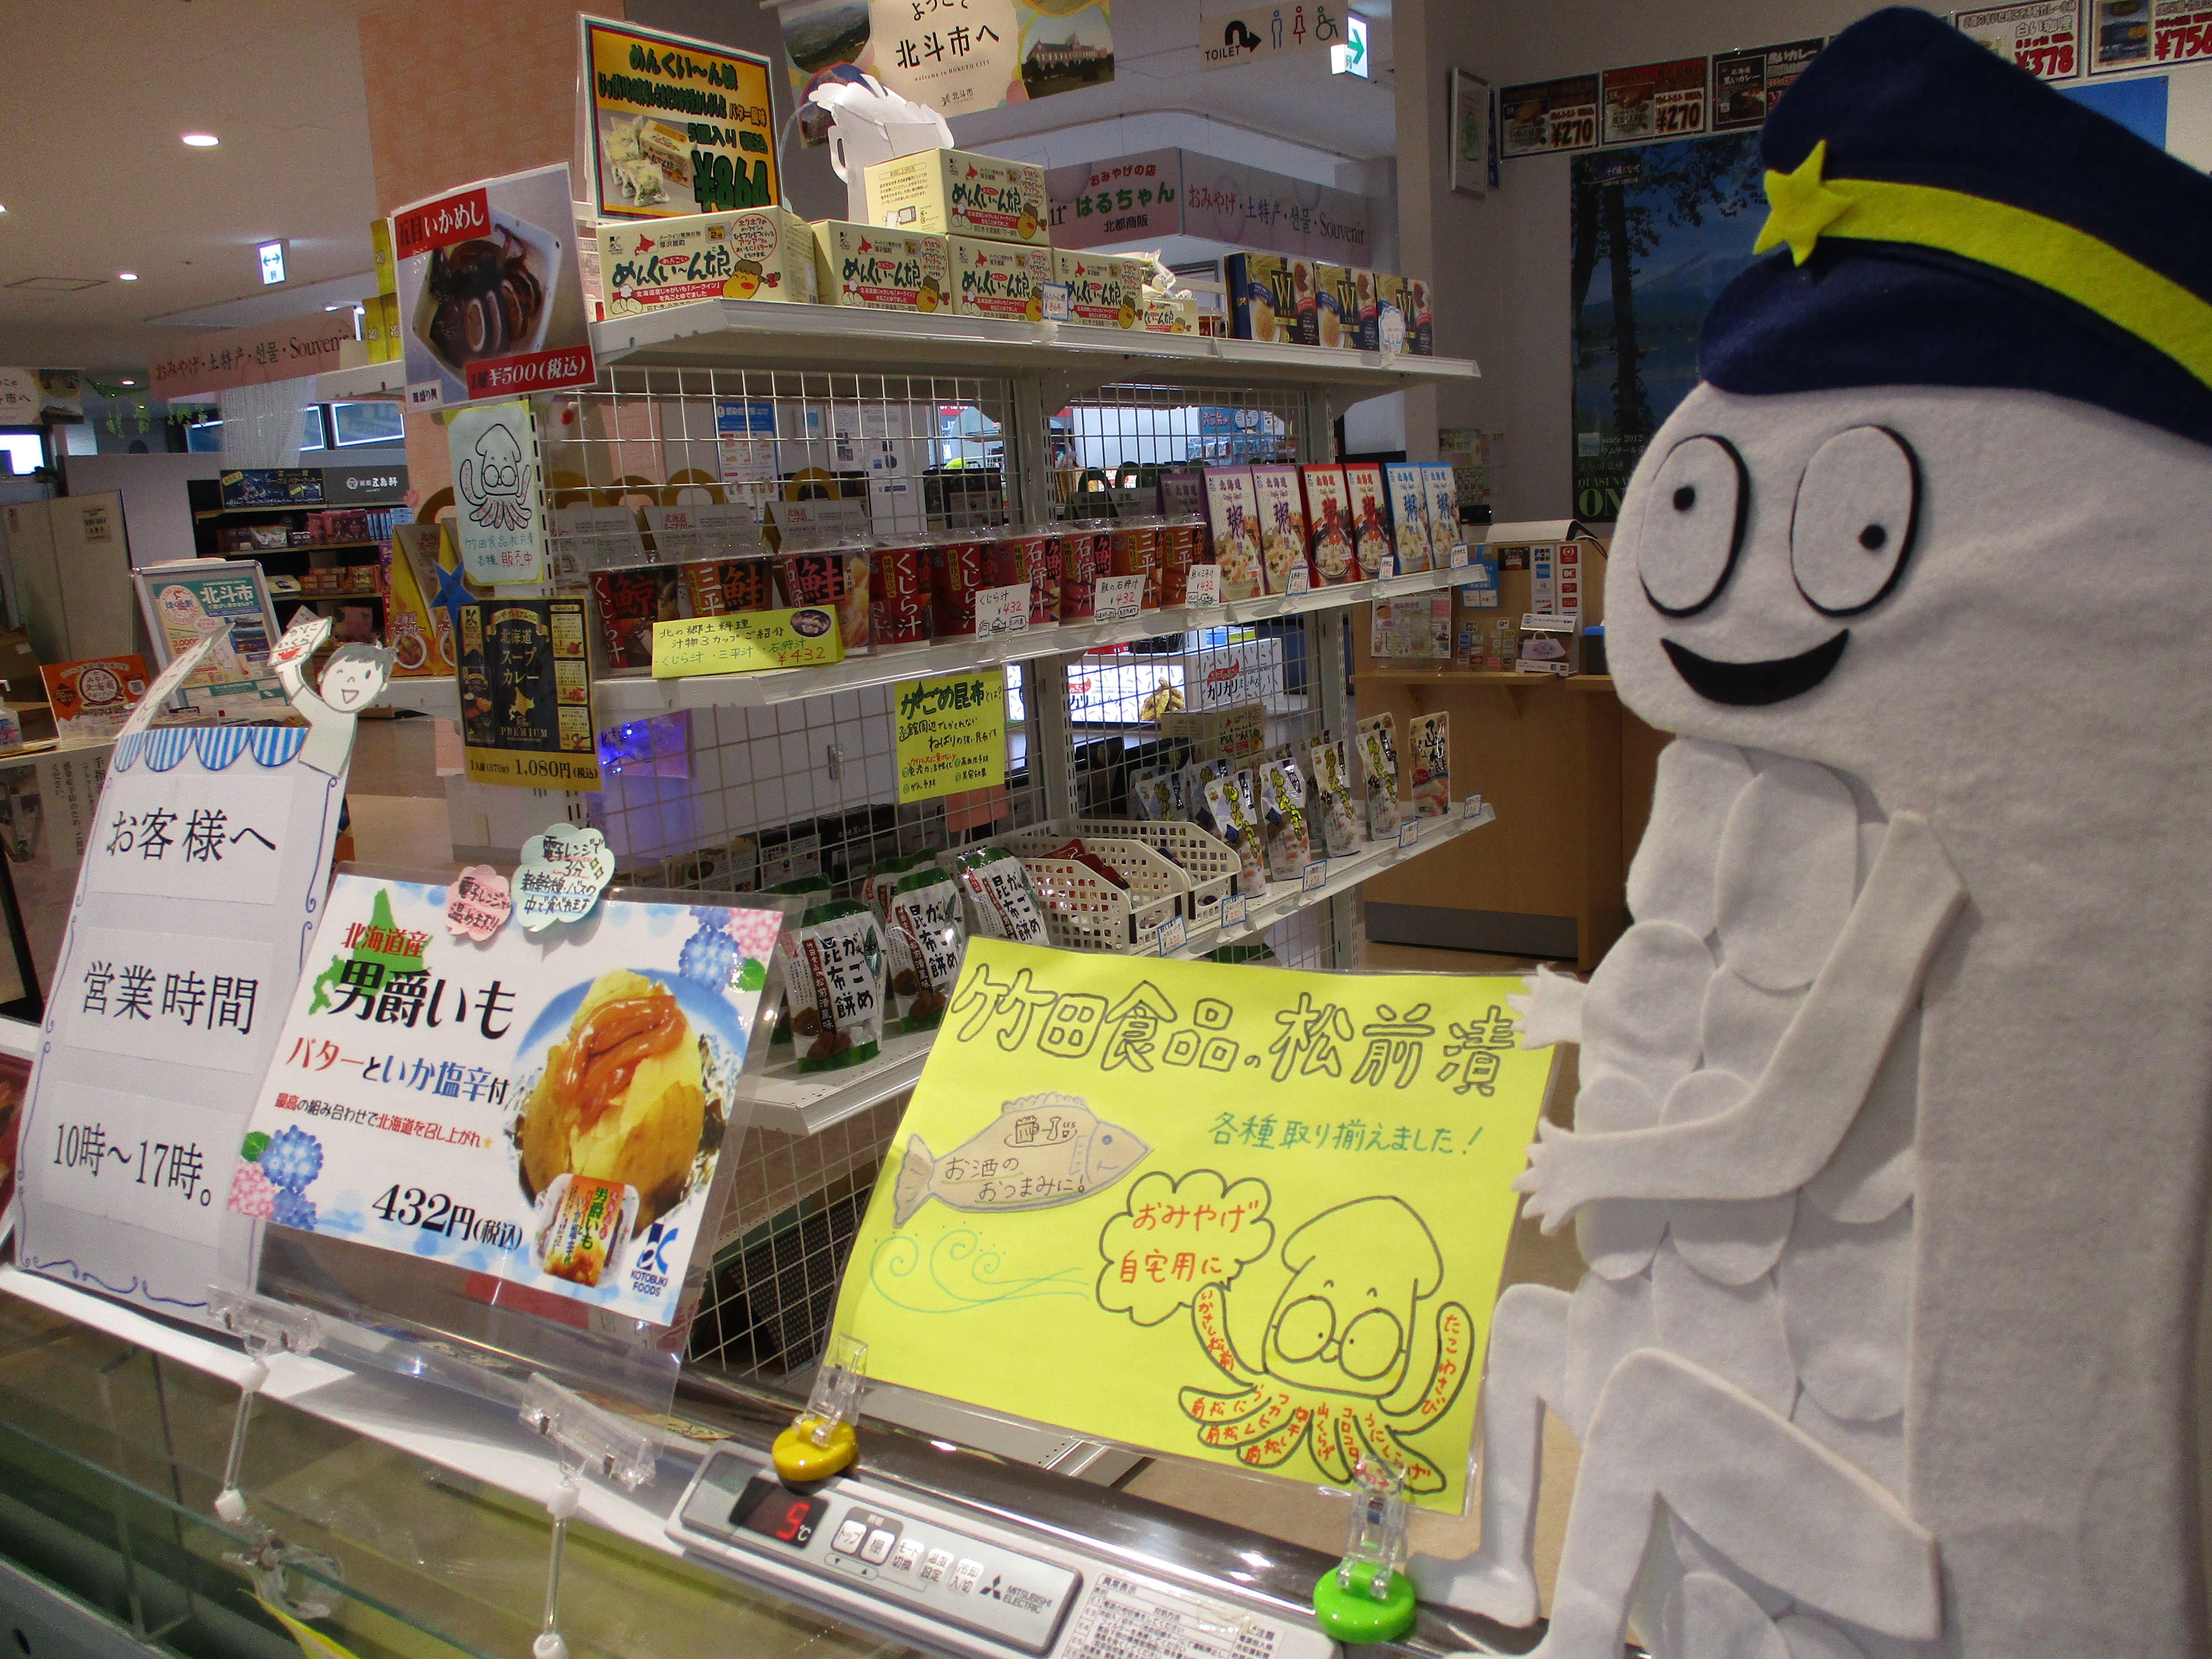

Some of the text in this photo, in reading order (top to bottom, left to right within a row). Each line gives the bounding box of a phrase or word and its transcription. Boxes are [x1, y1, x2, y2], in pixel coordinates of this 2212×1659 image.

[912, 0, 968, 21] よう
[895, 23, 1000, 70] 北斗市へ
[1205, 45, 1241, 61] TOILET
[914, 71, 939, 83] welcome
[948, 64, 974, 75] HOKUTO
[975, 59, 991, 69] CITY
[2014, 44, 2074, 76] ¥378
[951, 88, 974, 100] 北斗市
[729, 103, 767, 128] バター風味
[1655, 102, 1701, 135] ¥270
[1550, 119, 1594, 149] ¥270
[1088, 163, 1157, 188] おみやげの店
[1075, 180, 1176, 219] はるちゃん
[1103, 213, 1149, 234] 北都商販
[1188, 184, 1237, 214] おみやげ
[1319, 211, 1366, 246] Souvenir
[659, 240, 686, 250] 厚沢部町
[636, 283, 720, 298] 北海道産じゃがいも「メークイン」
[1271, 275, 1293, 312] W
[1337, 283, 1357, 319] W
[1044, 302, 1062, 313] ¥864
[290, 328, 349, 359] Souven
[489, 356, 586, 386] ¥500(税込)
[1623, 434, 1644, 443] 2012
[501, 550, 533, 568] 販売中
[1534, 548, 1551, 561] JCB
[799, 556, 844, 601] 鮭
[1025, 539, 1048, 619] 石狩汁
[1100, 579, 1139, 594] 鮭の石狩汁
[1190, 569, 1214, 580] 鮭の三平汁
[1196, 580, 1214, 591] ¥432
[200, 584, 253, 604] 北斗市
[896, 552, 921, 639] くじら汁
[979, 590, 1010, 604] くじら汁
[1110, 592, 1135, 606] ¥432
[593, 576, 625, 665] くじら汁
[997, 602, 1023, 616] ¥432
[500, 628, 532, 644] 北海道
[659, 619, 752, 639] 北の郷土料理
[501, 647, 537, 666] スープ
[777, 646, 827, 666] ¥432
[502, 668, 540, 685] カレー
[900, 680, 1003, 720] がごめ昆布とは?
[500, 726, 548, 738] PREMIUM
[899, 717, 978, 742] 函館周辺でしかとれない
[928, 728, 997, 753] ねばりの強い昆布です
[515, 759, 571, 778] 1,080円
[574, 768, 598, 779] (税込)
[960, 754, 989, 766] 高血圧予防
[910, 767, 987, 792] がん予防 美容効果
[106, 807, 276, 863] お客様へ
[543, 835, 605, 862] 電子レンジで
[564, 860, 585, 876] 3分
[520, 869, 597, 893] 新幹線・バスの
[525, 895, 591, 915] 中で食べれます
[992, 872, 1042, 942] がごめ 昆布餅
[341, 921, 429, 958] 北海道産
[909, 904, 948, 978] 昆布餅
[820, 932, 874, 1019] がごめ 昆布餅
[82, 961, 259, 1035] 営業時間
[328, 959, 516, 1039] 男爵いも
[948, 962, 1516, 1097] 竹田食品の松前漬
[286, 1036, 510, 1106] バターといか塩辛付
[274, 1091, 481, 1149] 最高の組み合わせで北海道を召し上がれ
[1208, 1112, 1480, 1157] 各種取り揃えました!
[942, 1154, 1021, 1183] お酒の
[978, 1176, 1087, 1203] おつまみに!
[372, 1184, 523, 1250] 432円(税込)
[1132, 1200, 1261, 1232] おみやげ
[630, 1269, 668, 1288] KOTOBUKI
[1118, 1249, 1223, 1284] 自宅用に
[632, 1281, 662, 1297] FOODS
[1420, 1313, 1460, 1416] たこわさび
[1316, 1402, 1337, 1462] 山くらげ
[838, 1528, 864, 1546] トップ
[870, 1537, 885, 1556] 棚
[892, 1556, 913, 1572] 切換
[927, 1551, 950, 1568] 温度
[955, 1561, 981, 1578] 冷却
[920, 1566, 943, 1583] 設定
[1003, 1594, 1042, 1614] ELECTRIC
[1007, 1584, 1054, 1607] MITSUBISHI
